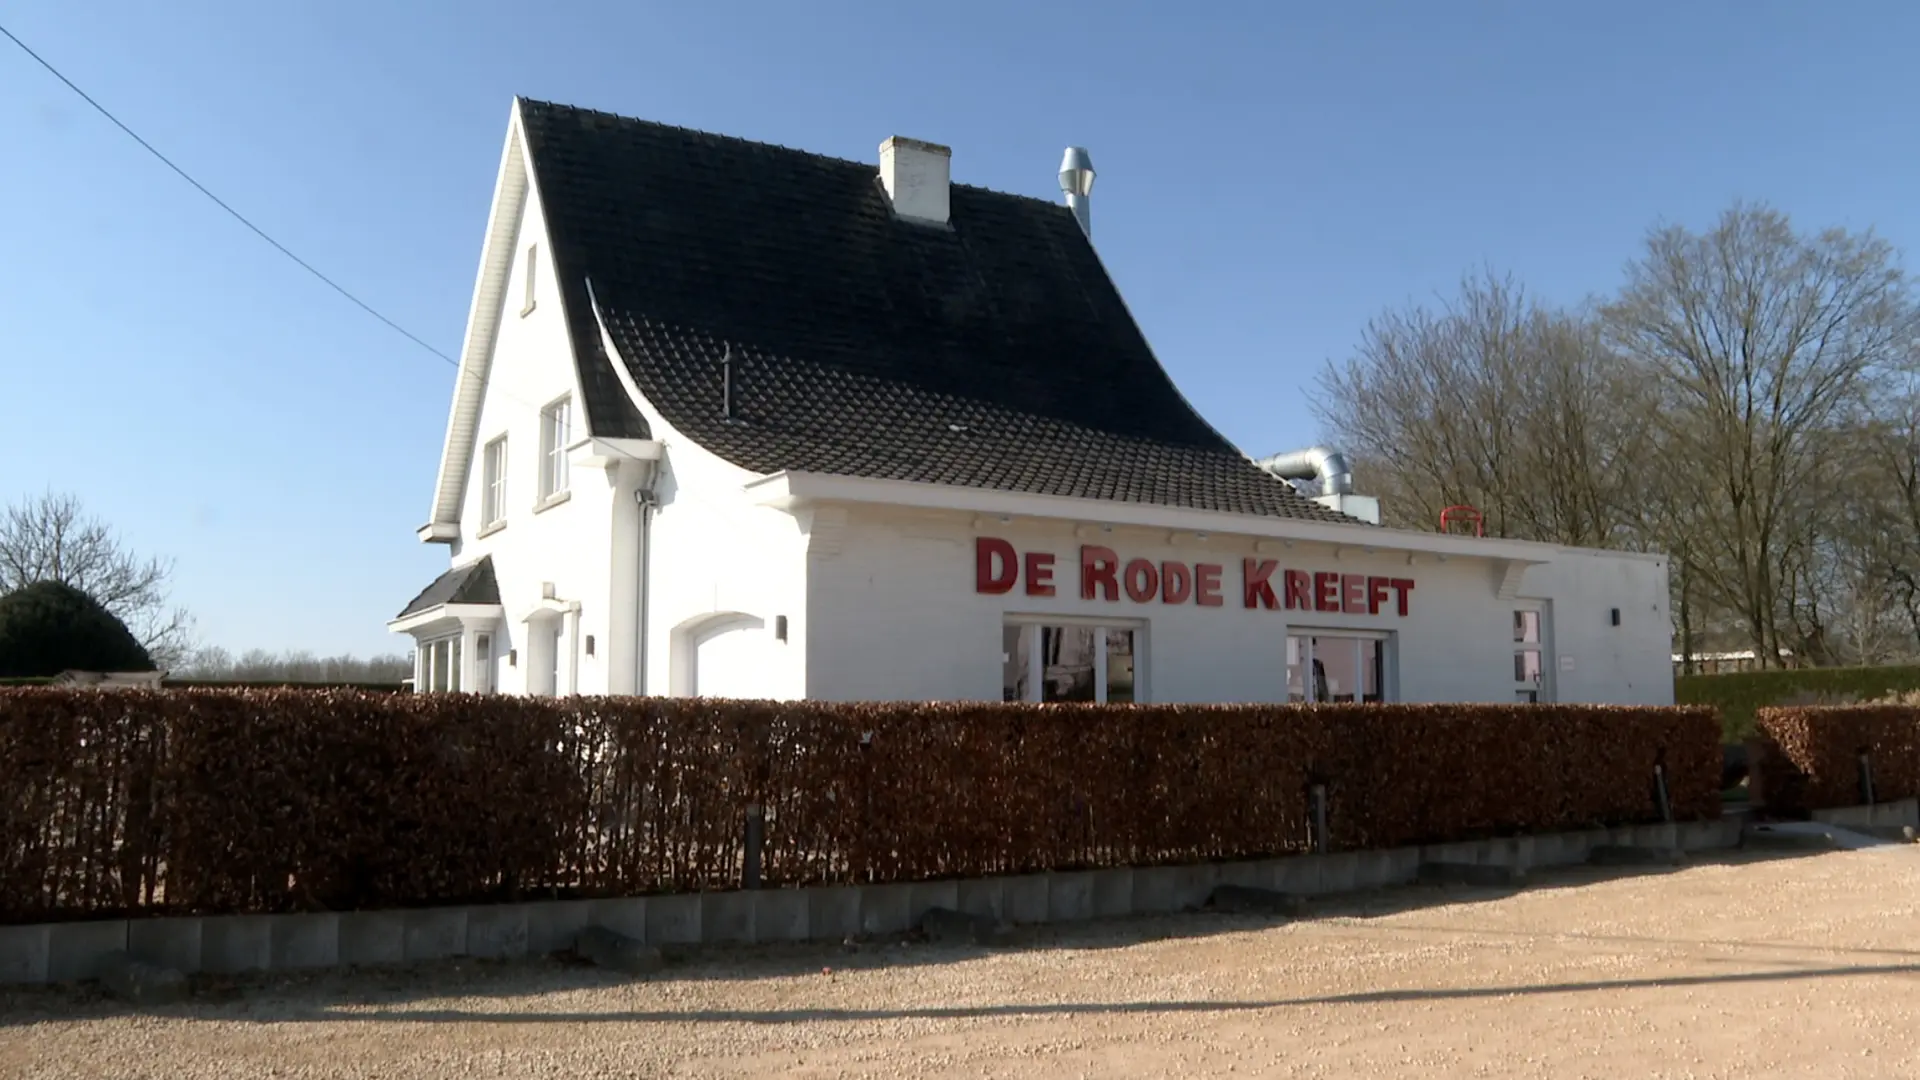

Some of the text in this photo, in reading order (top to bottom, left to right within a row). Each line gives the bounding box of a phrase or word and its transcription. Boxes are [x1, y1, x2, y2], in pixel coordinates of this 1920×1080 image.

[976, 537, 1415, 616] DE RODE KREEFT
